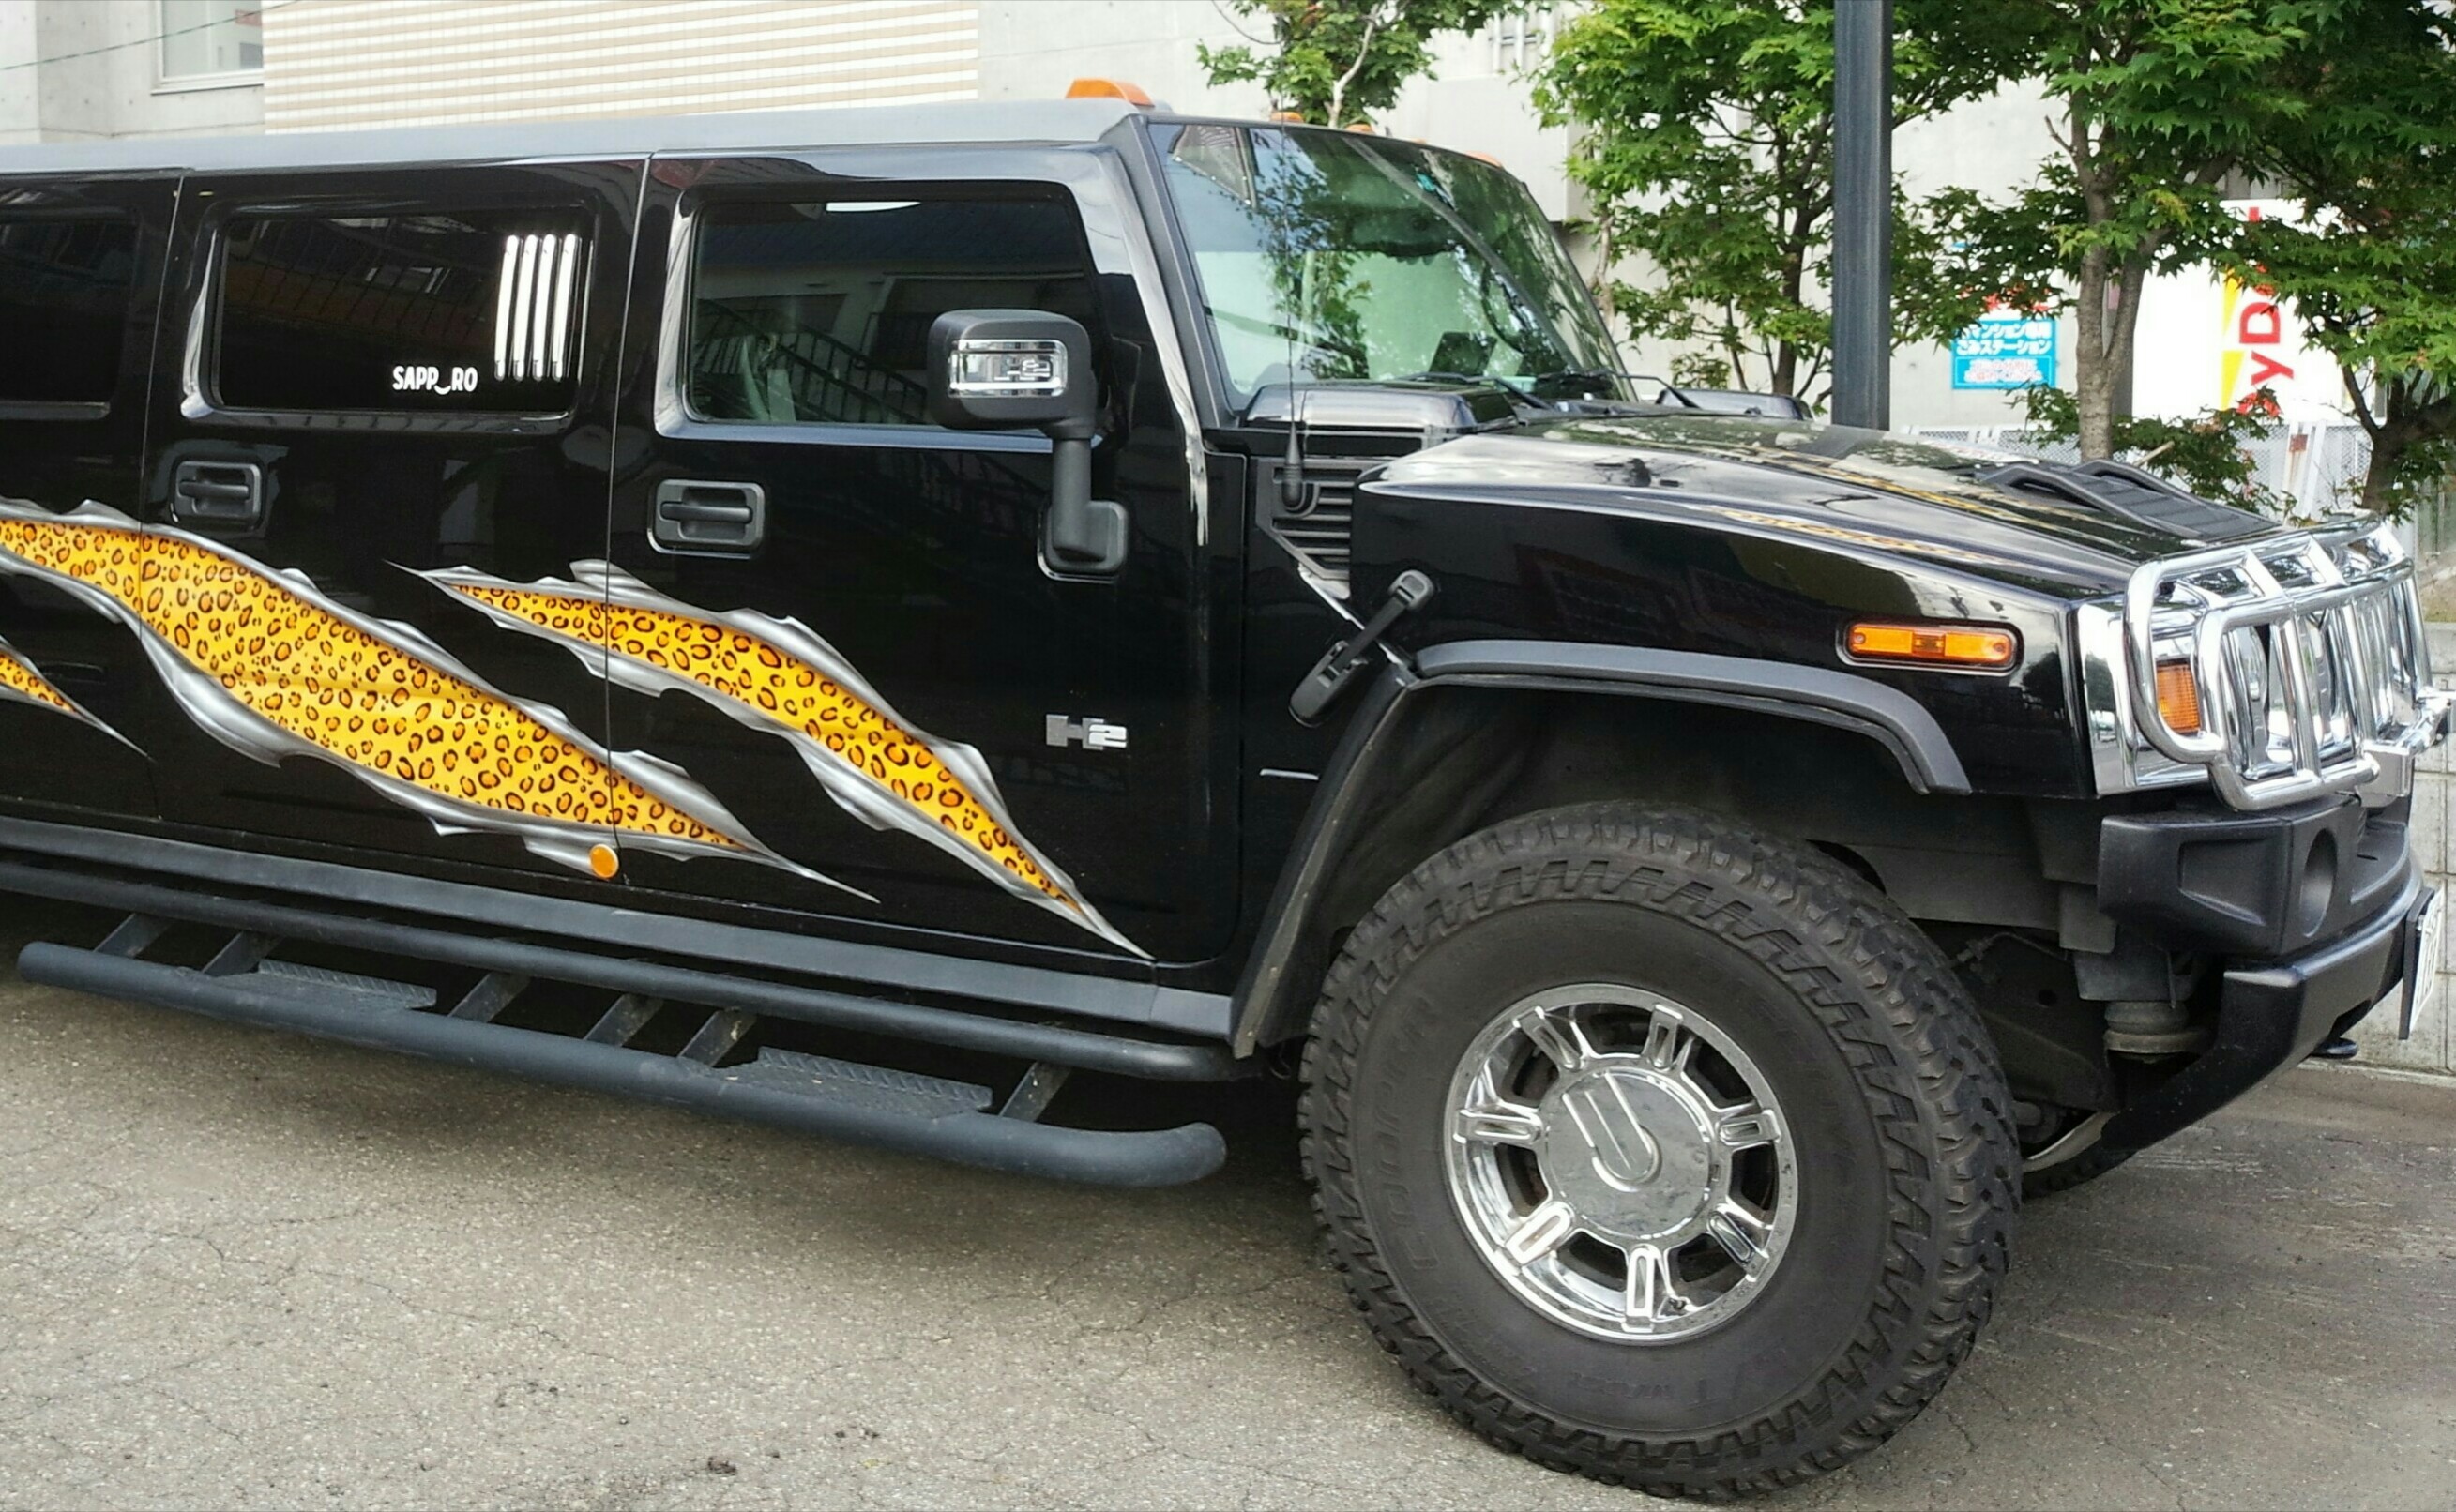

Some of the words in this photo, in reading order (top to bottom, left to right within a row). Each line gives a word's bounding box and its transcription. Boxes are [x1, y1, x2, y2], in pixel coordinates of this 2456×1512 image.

[1956, 339, 2053, 355] ごみステーション
[1045, 713, 1128, 750] H2
